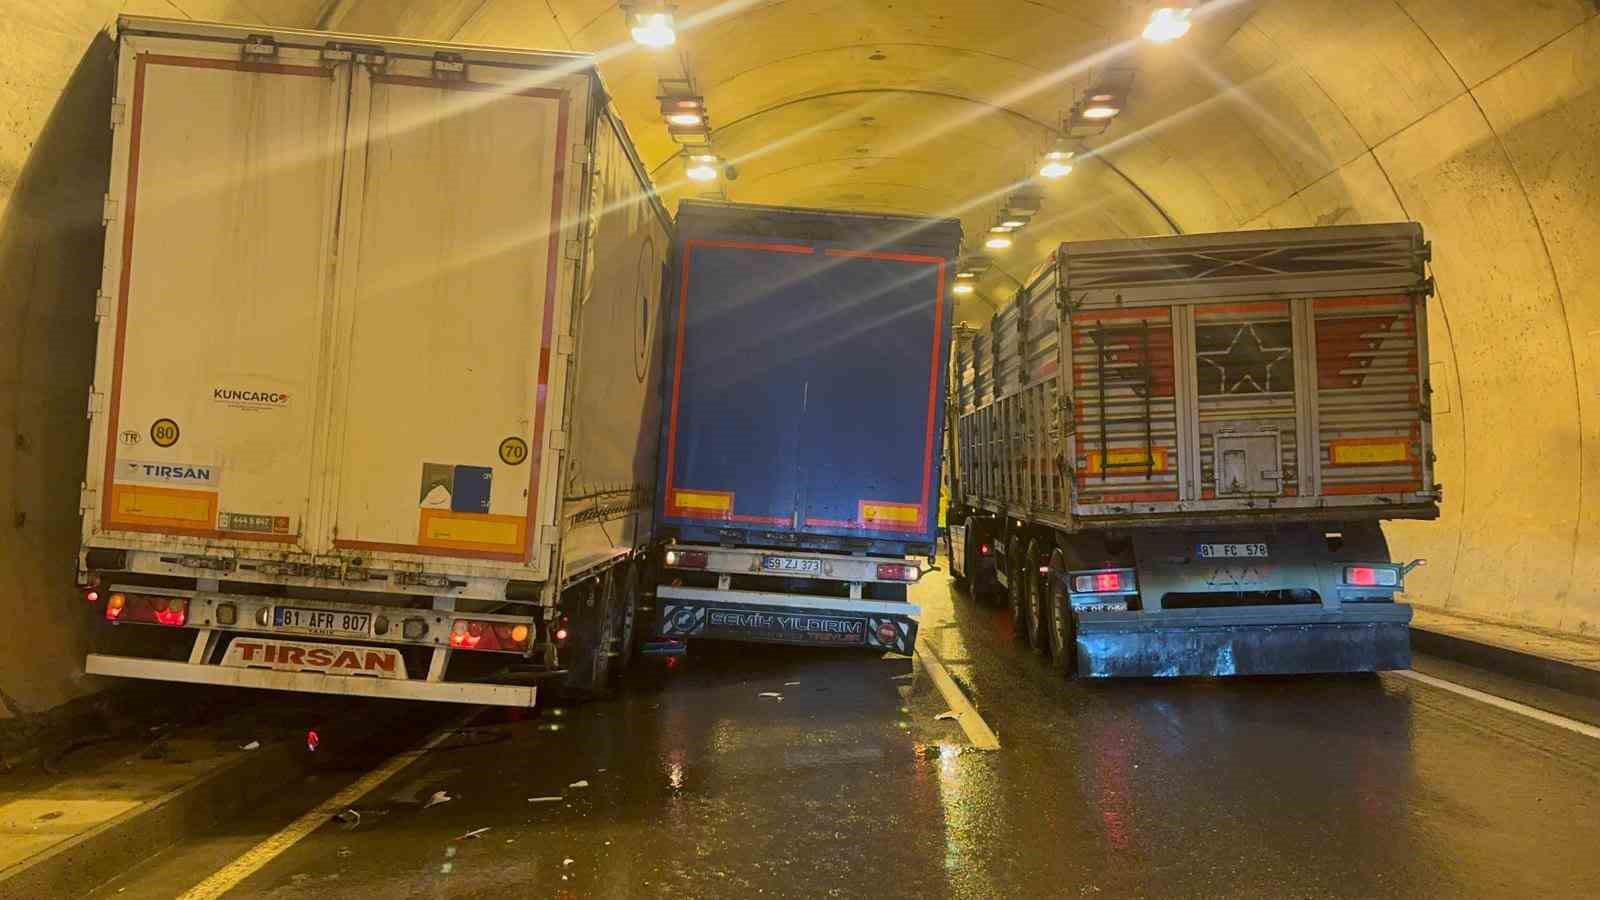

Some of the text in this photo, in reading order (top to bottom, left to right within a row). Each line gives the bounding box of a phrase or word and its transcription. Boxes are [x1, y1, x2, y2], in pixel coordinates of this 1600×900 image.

[124, 433, 138, 443] TR
[156, 426, 174, 440] 80
[505, 446, 523, 459] 70
[143, 464, 210, 480] TIRSAN
[1202, 545, 1266, 556] 81 FC 578
[769, 558, 819, 570] 59 ZJ 373
[284, 610, 368, 633] 81 AFR 807
[777, 616, 862, 633] YILDIRIM
[235, 643, 395, 672] TIRSAN
